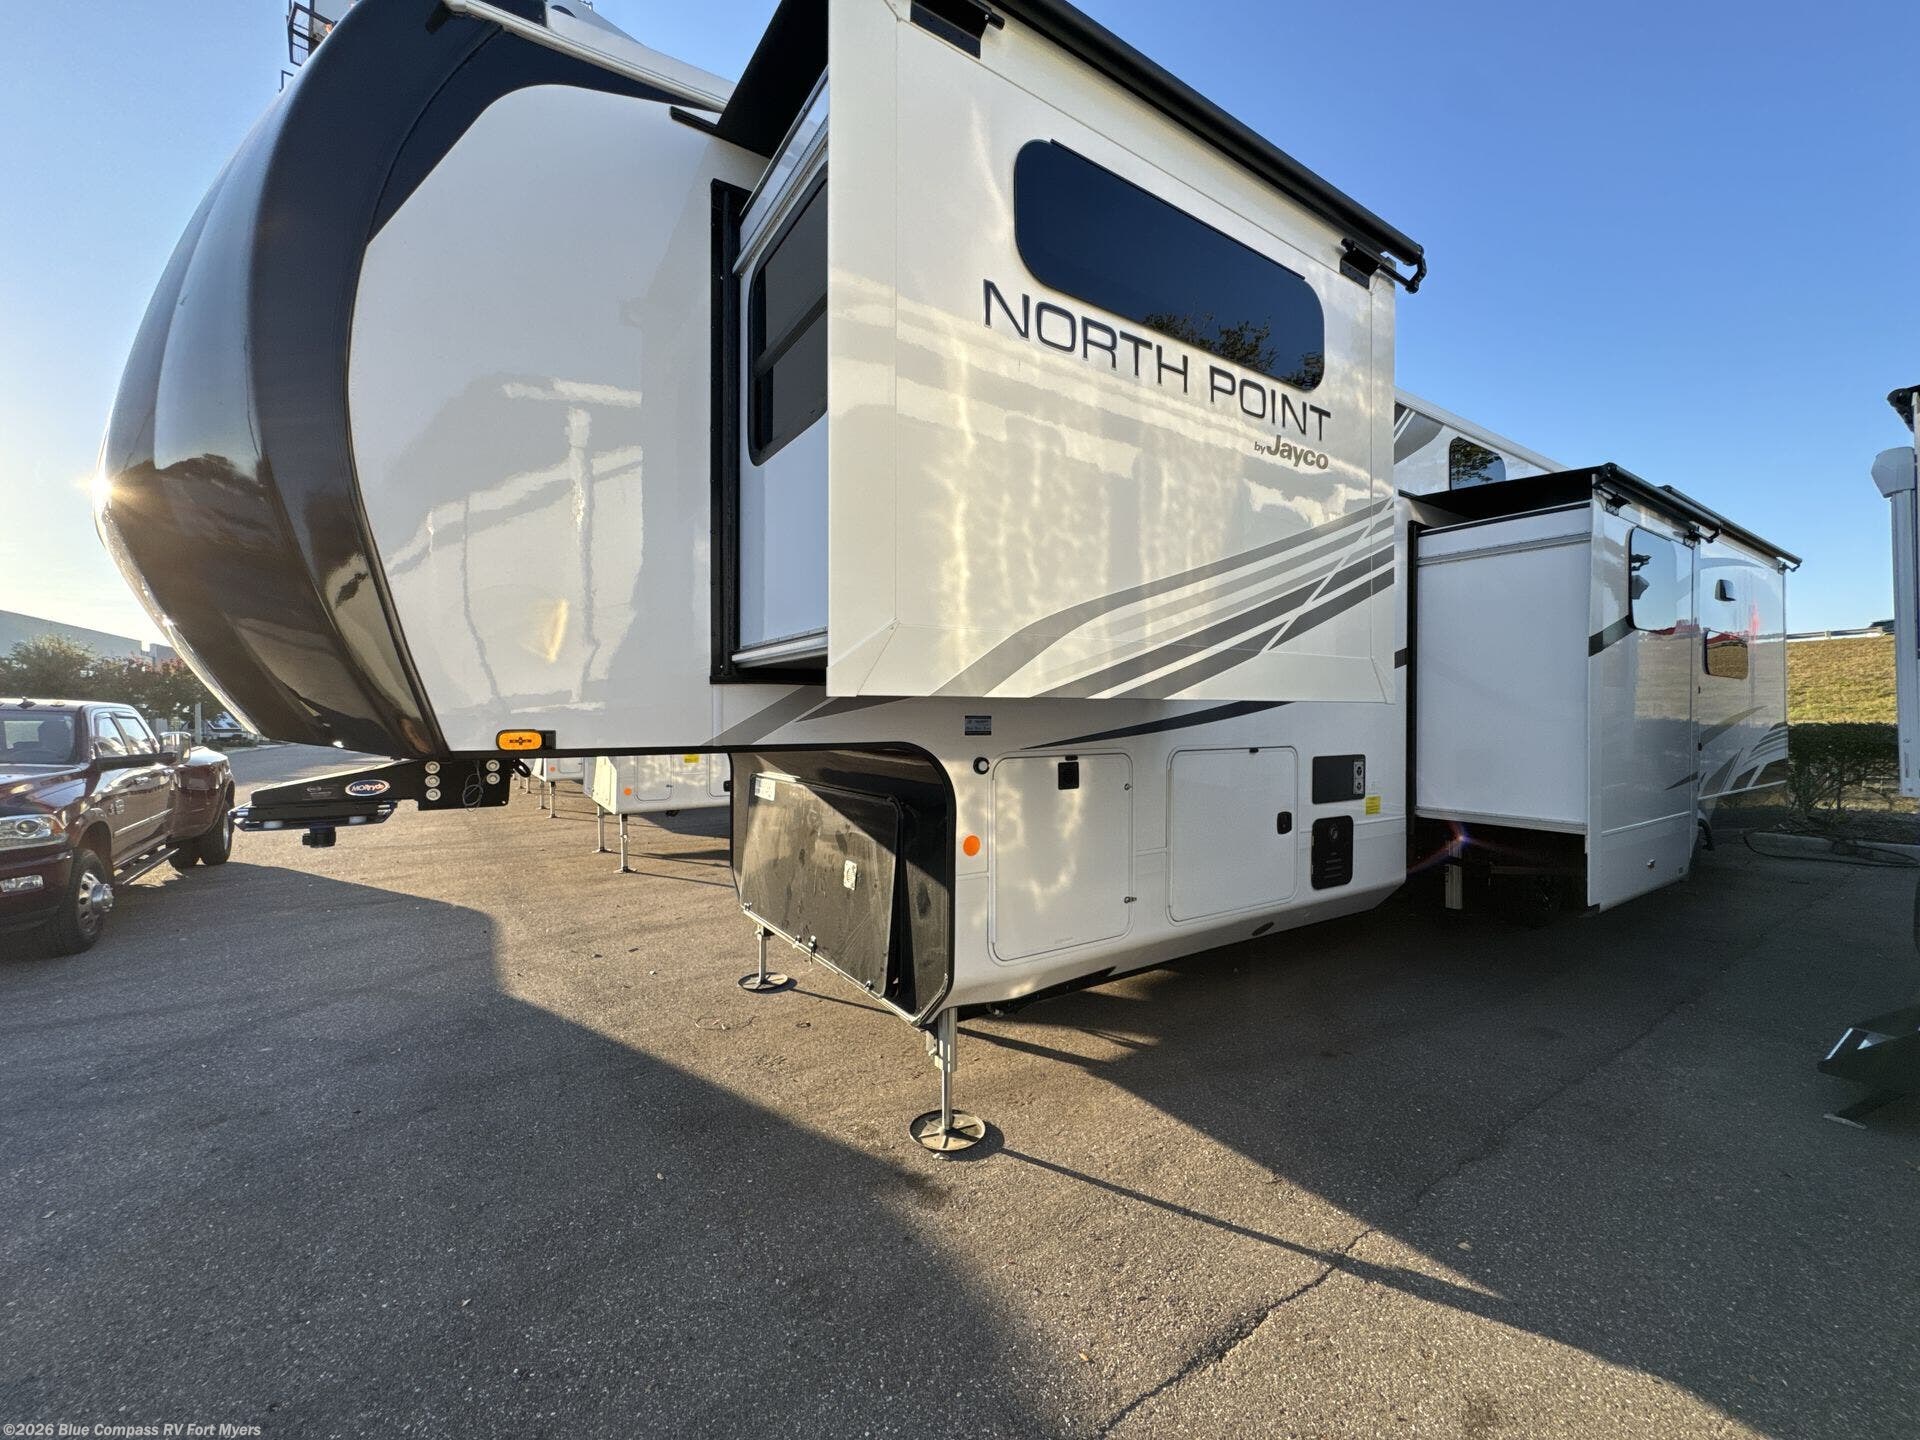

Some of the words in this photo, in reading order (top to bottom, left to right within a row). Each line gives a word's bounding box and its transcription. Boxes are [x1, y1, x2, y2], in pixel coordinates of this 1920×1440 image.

[983, 278, 1189, 394] NORTH
[1209, 365, 1332, 442] POINT
[1254, 441, 1267, 455] by
[1266, 434, 1330, 470] Jayco
